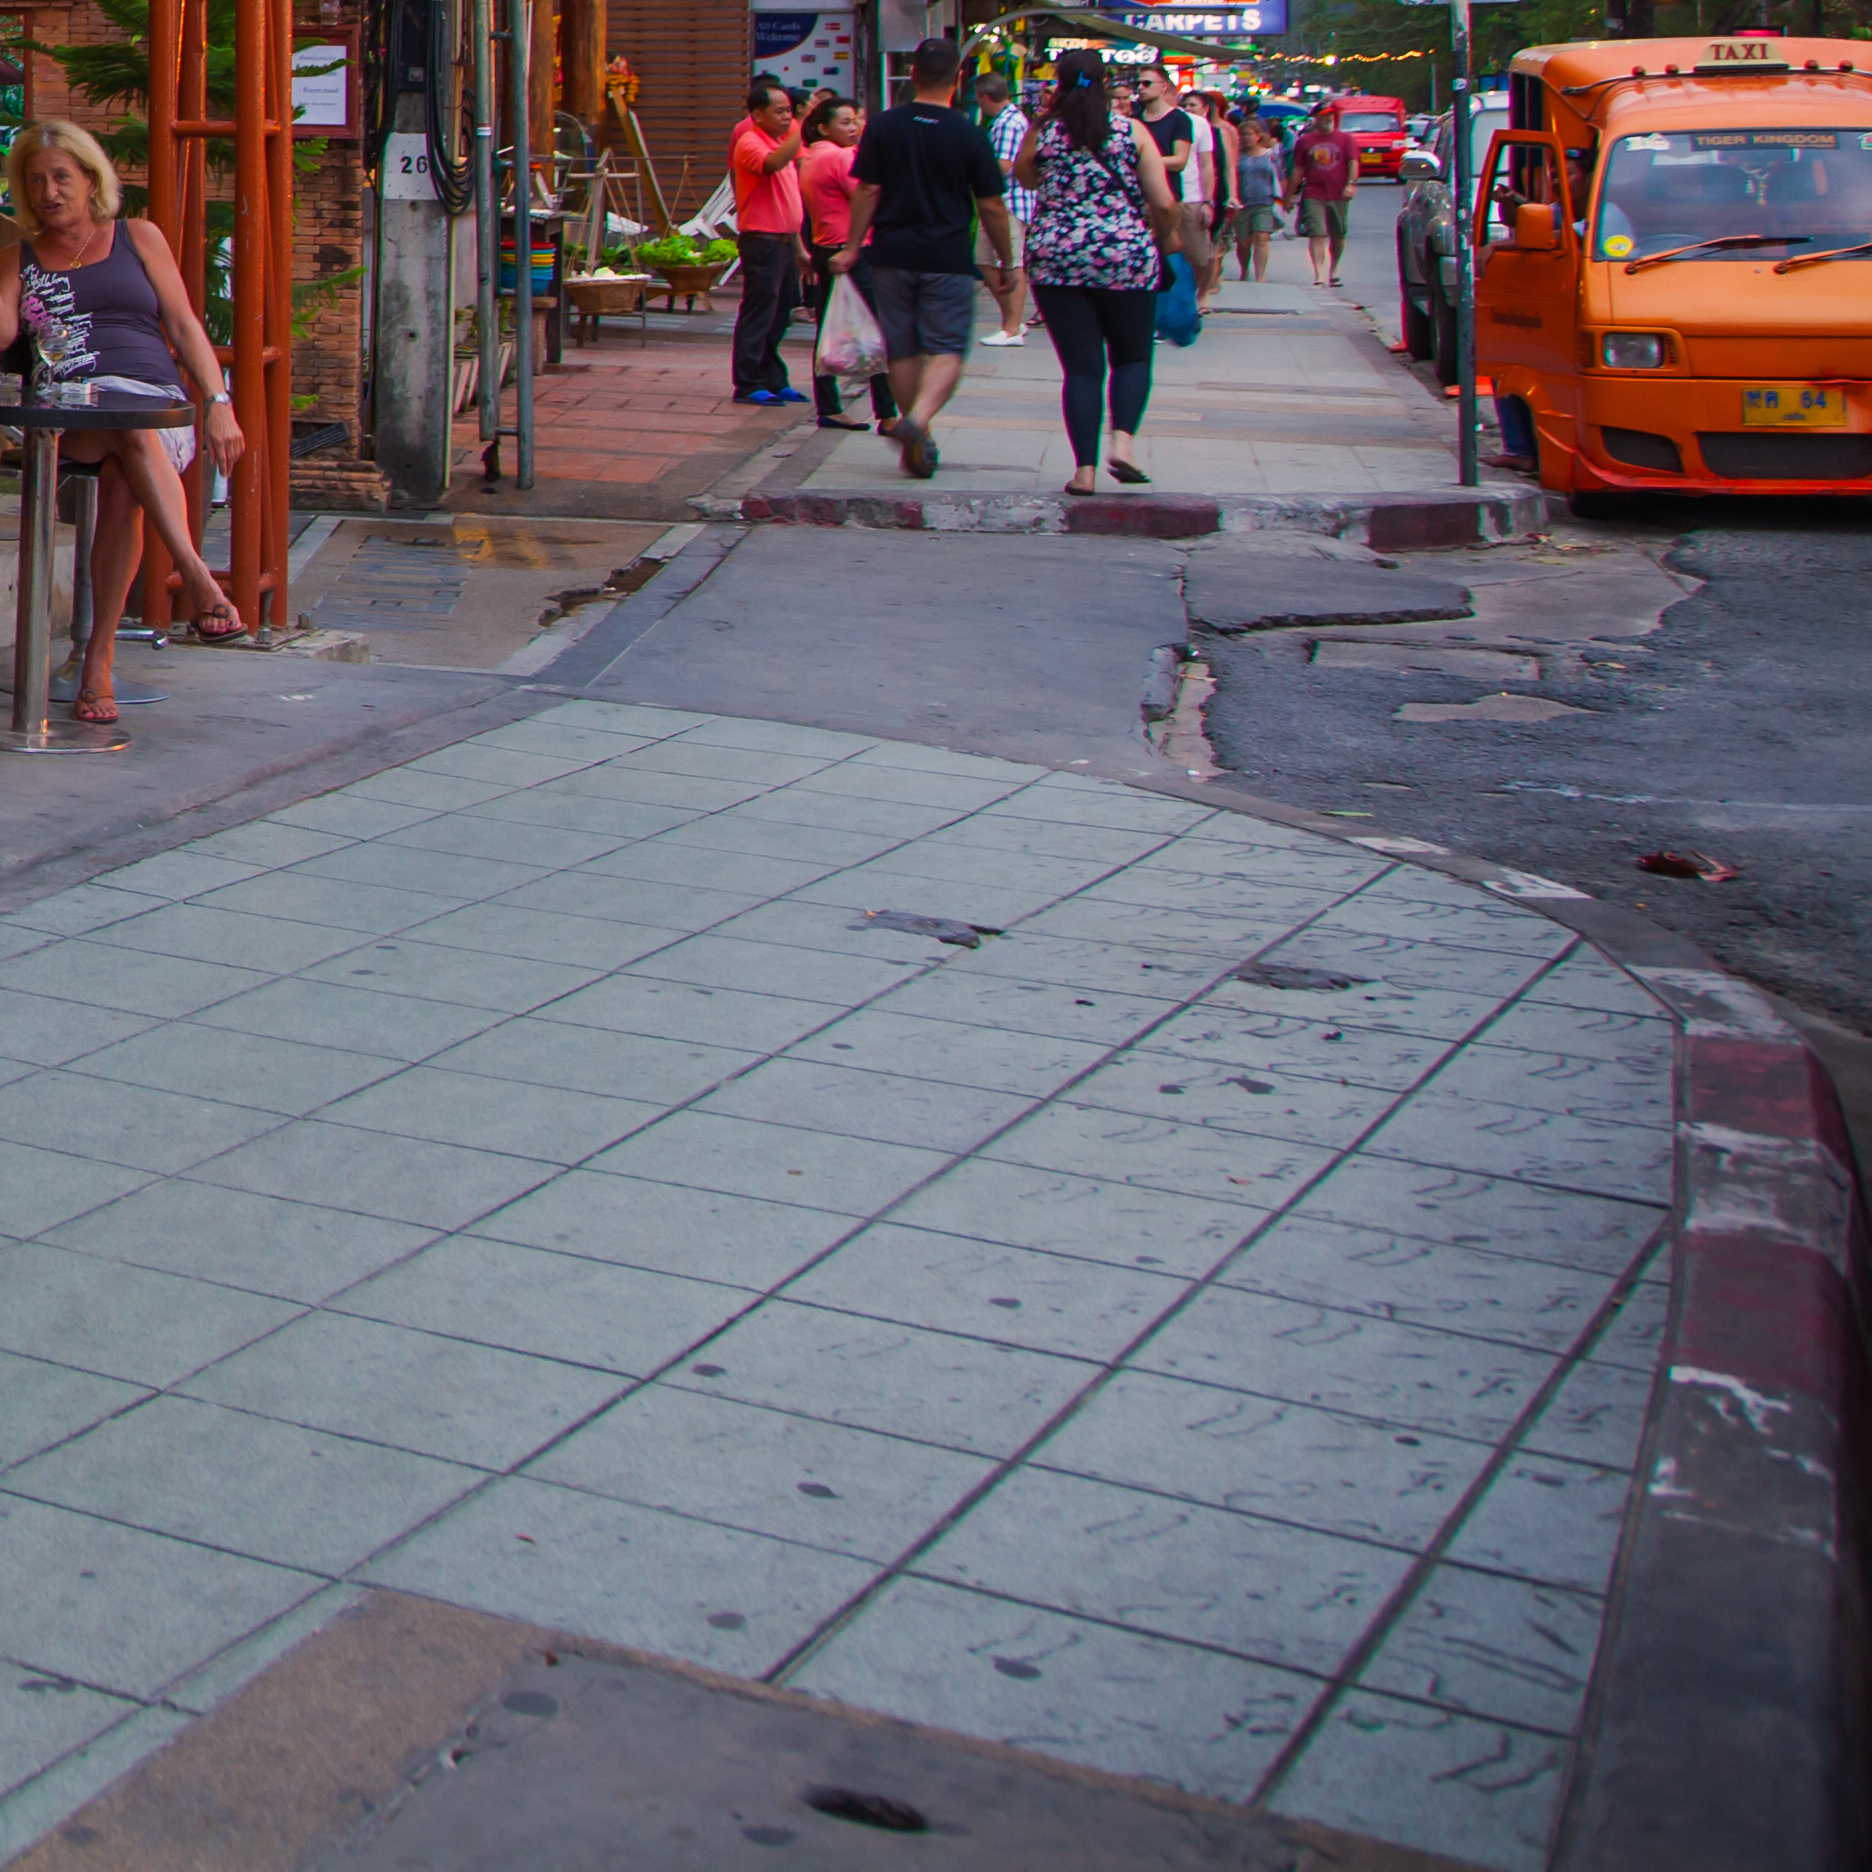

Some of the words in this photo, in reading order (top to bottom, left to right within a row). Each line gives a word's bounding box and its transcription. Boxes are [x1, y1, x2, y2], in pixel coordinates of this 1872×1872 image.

[1044, 43, 1159, 64] TTOO
[1710, 43, 1769, 60] TAXI
[1696, 135, 1747, 146] TIGER
[1752, 134, 1837, 145] KINGDOM
